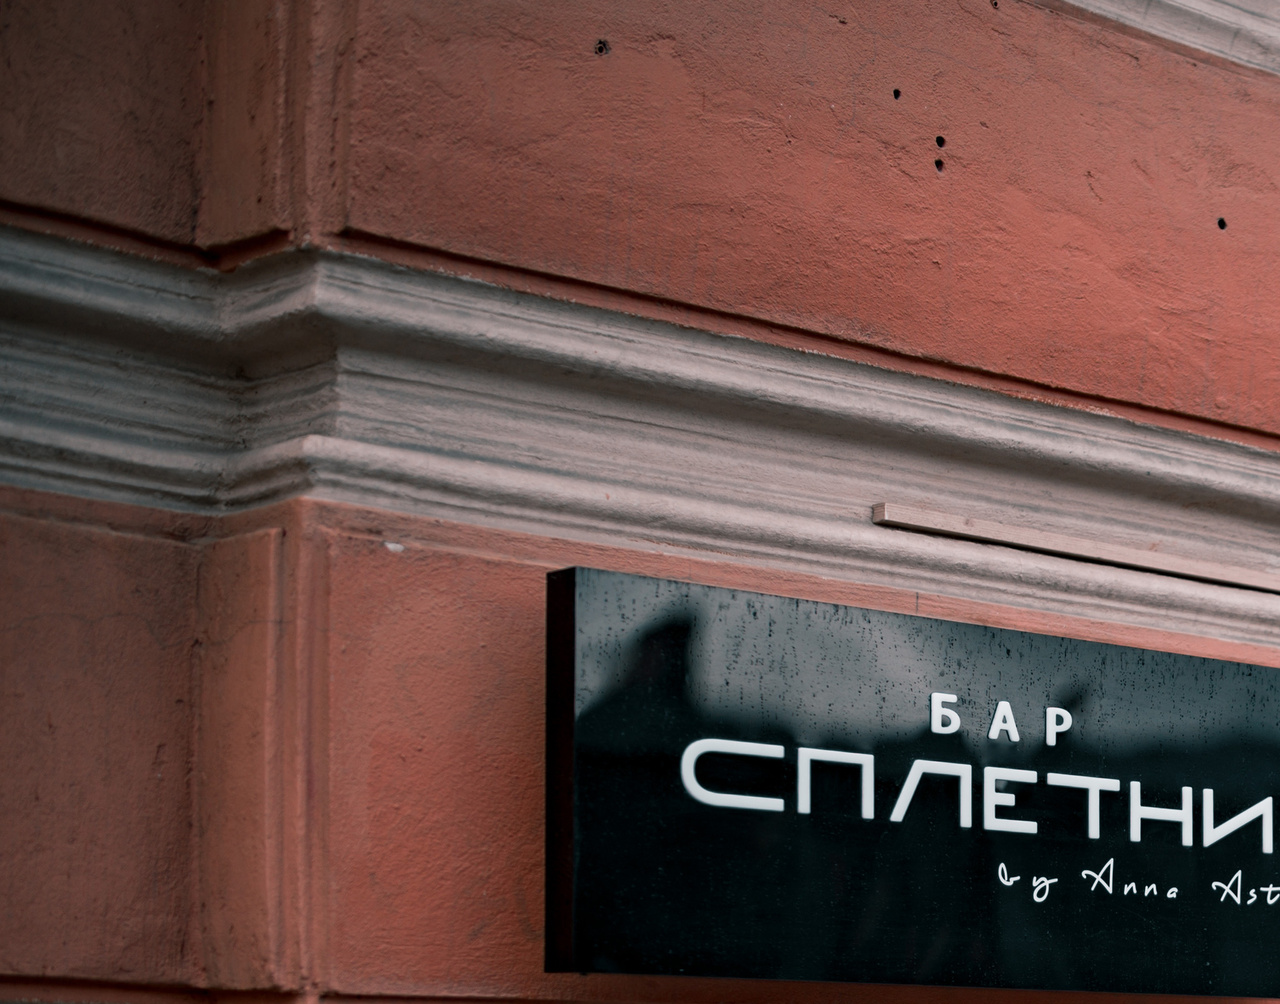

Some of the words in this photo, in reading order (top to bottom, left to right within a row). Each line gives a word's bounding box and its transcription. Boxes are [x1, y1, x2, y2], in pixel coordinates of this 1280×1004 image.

[930, 691, 1073, 746] БАР
[681, 738, 1273, 854] СПЛЕТНИ
[998, 862, 1059, 903] by
[1081, 857, 1179, 899] Anna
